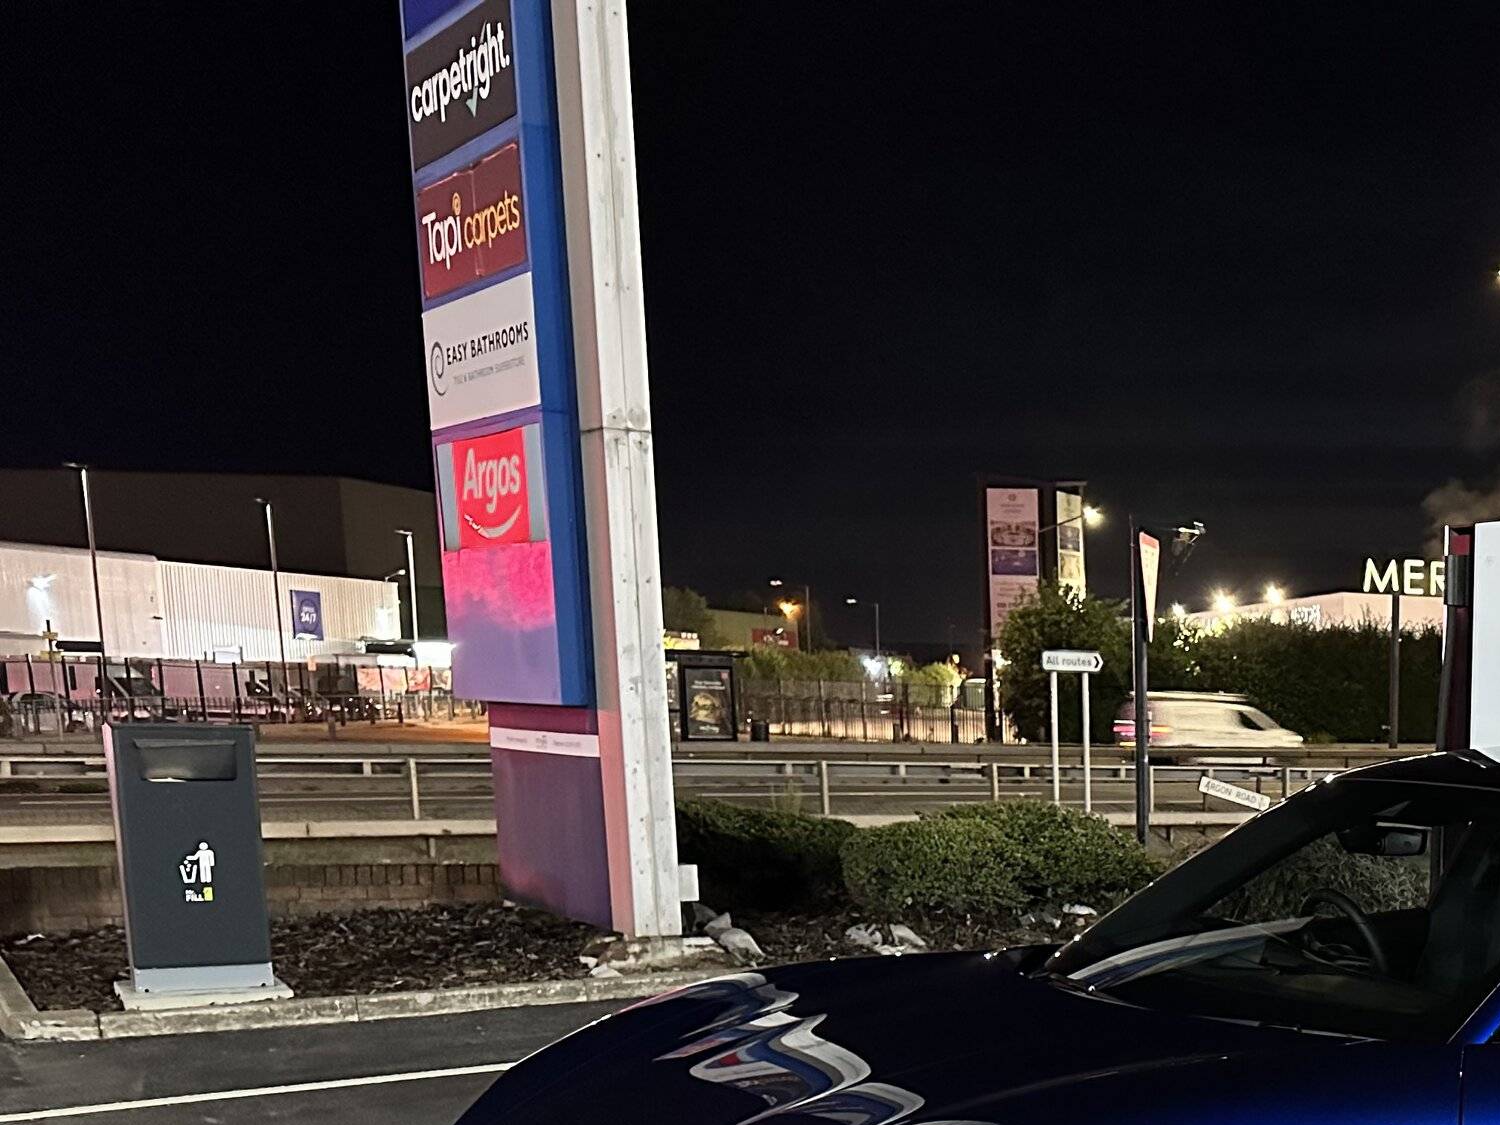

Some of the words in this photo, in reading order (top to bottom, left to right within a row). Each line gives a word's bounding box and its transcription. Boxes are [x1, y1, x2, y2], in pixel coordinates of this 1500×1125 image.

[422, 192, 463, 270] Tapi
[464, 190, 520, 249] carpets
[446, 342, 468, 366] EASY
[470, 321, 529, 358] BATHROOMS
[463, 447, 521, 514] Argos
[1046, 656, 1059, 666] All
[1062, 657, 1092, 667] routes
[1204, 780, 1233, 796] ARGON
[1235, 791, 1257, 805] ROAD
